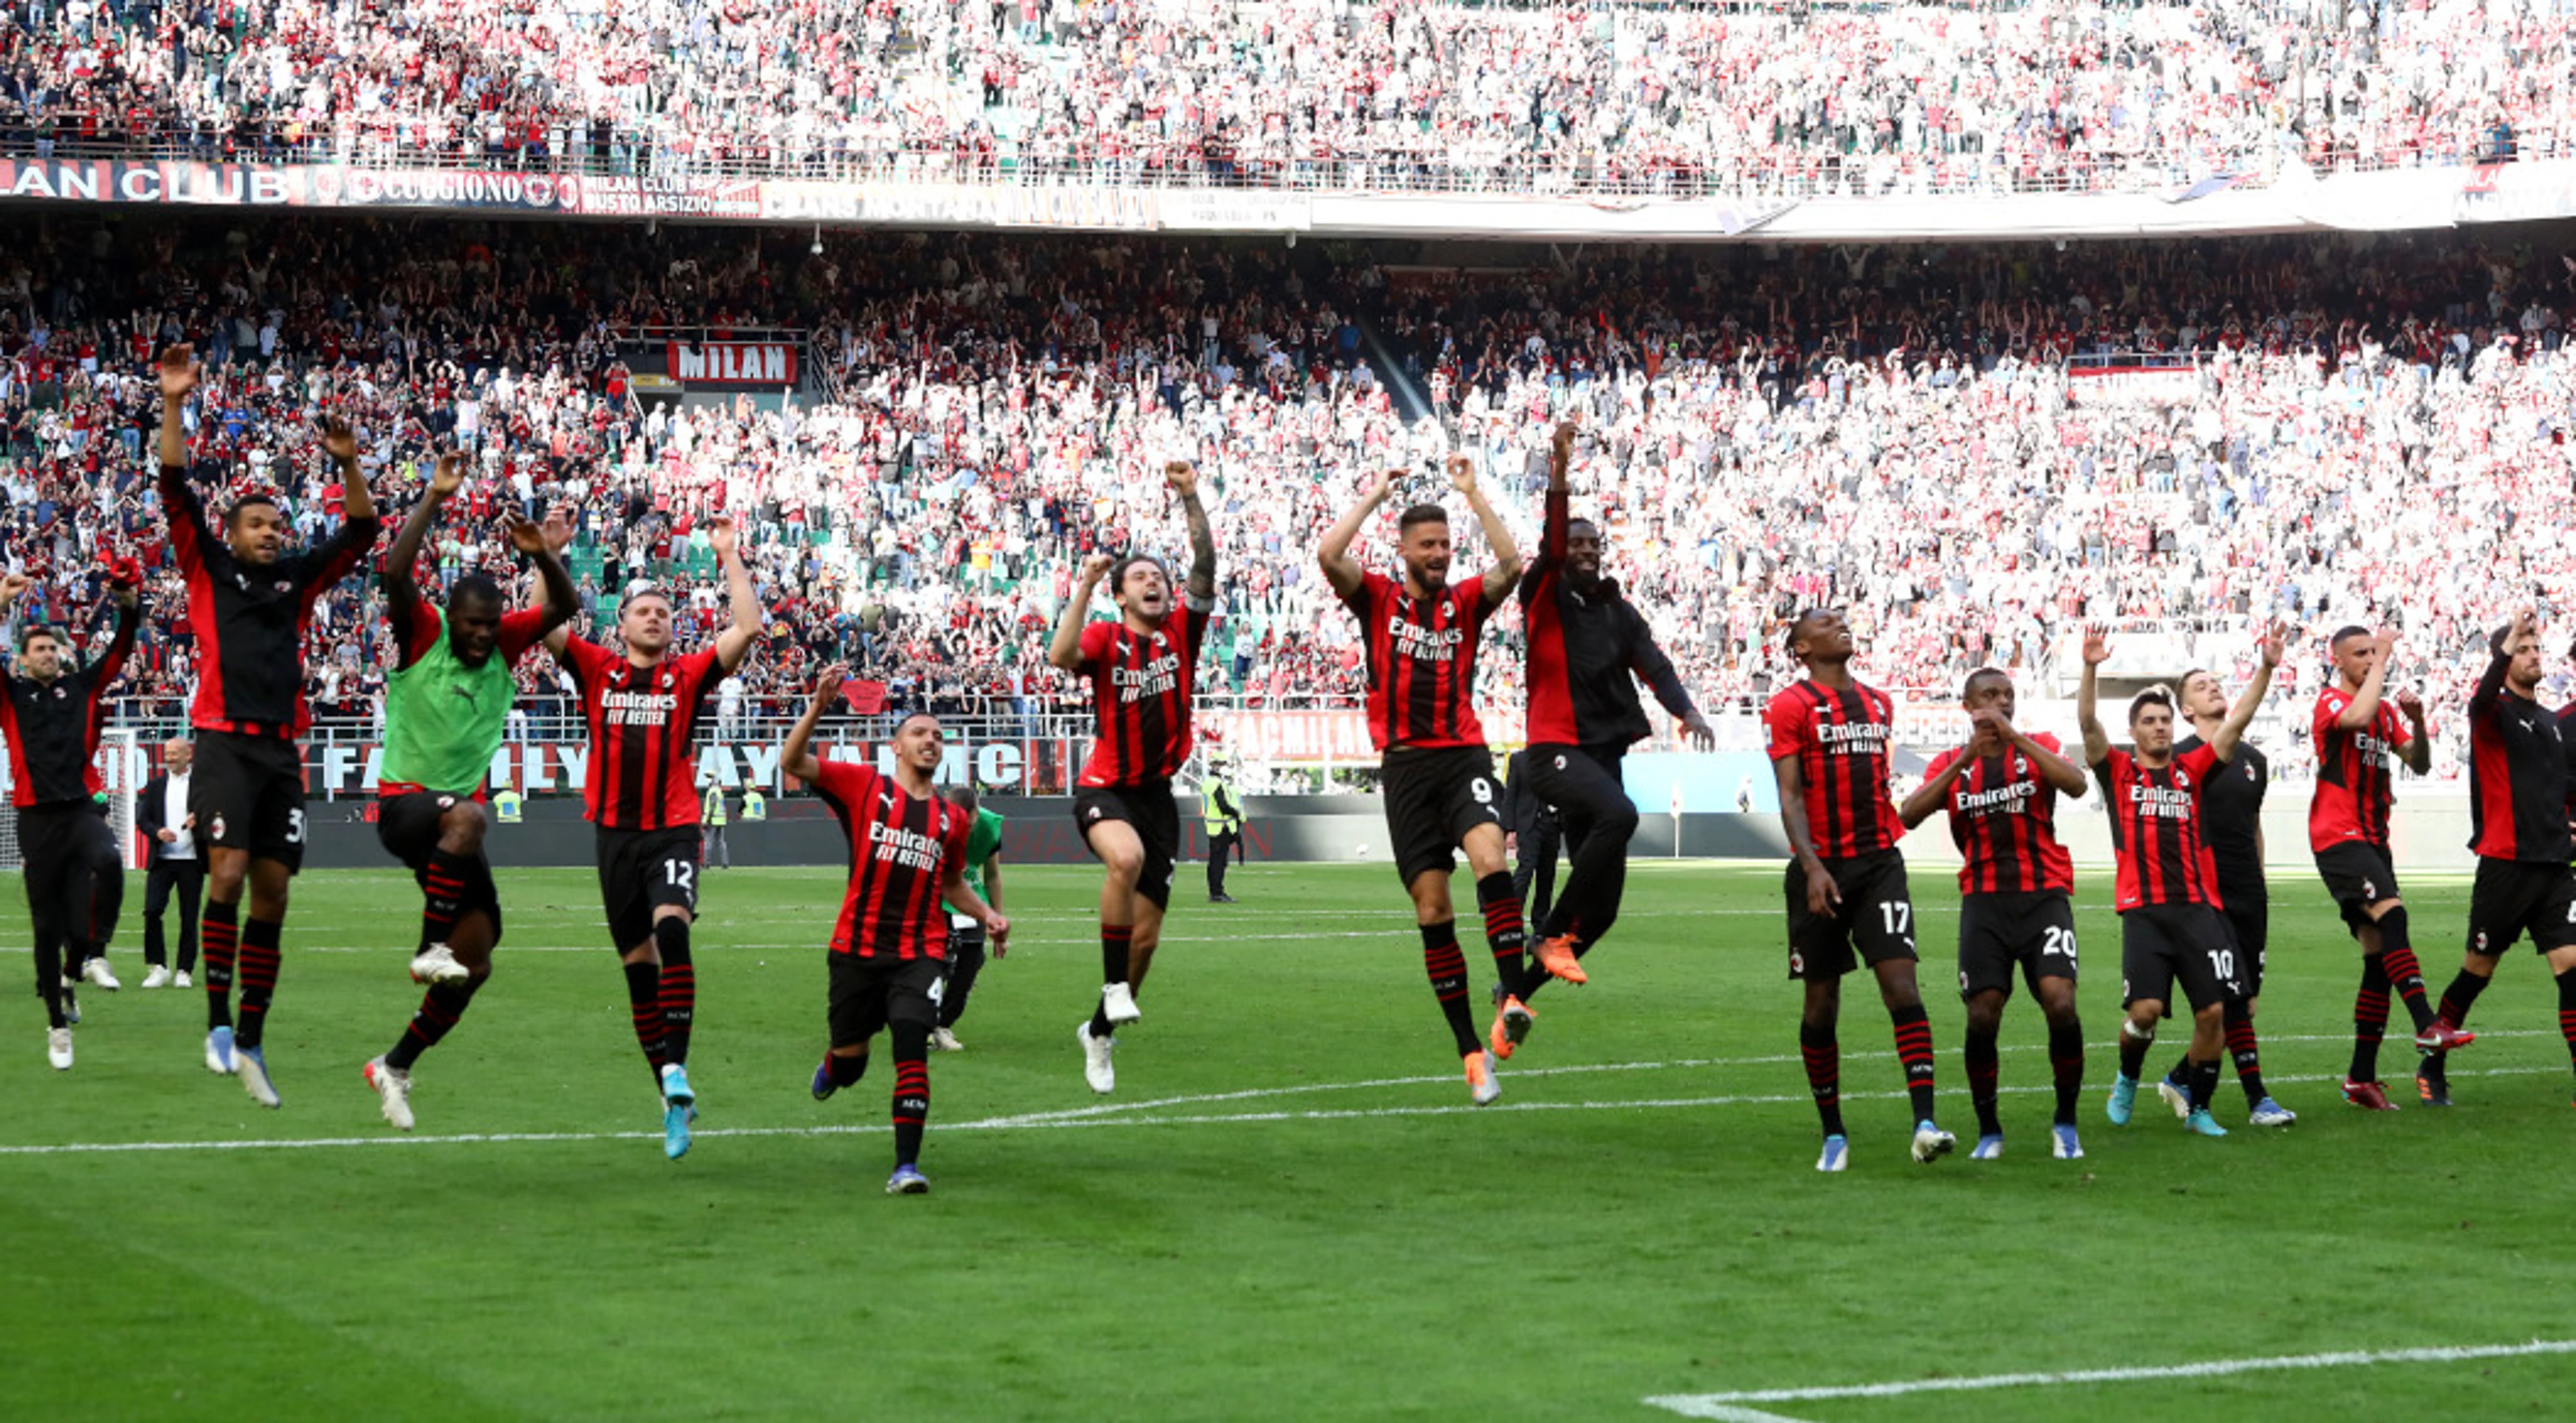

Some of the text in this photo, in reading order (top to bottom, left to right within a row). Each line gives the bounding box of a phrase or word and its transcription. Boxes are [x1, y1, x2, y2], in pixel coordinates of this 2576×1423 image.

[0, 166, 288, 203] AN CLUB
[382, 172, 521, 202] CUGGIONO
[583, 176, 637, 193] MILAN
[642, 178, 686, 193] CLUB
[584, 193, 711, 213] BUSTO ARSIZIO
[678, 346, 786, 380] MILAN
[1389, 615, 1463, 646] Emirates
[601, 687, 678, 710] Emirates
[1471, 778, 1493, 804] 9
[1955, 780, 2037, 811] Emirates
[286, 807, 307, 843] 3
[663, 858, 693, 890] 12
[1879, 900, 1910, 935] 17
[2043, 925, 2077, 958] 20
[2207, 949, 2234, 980] 10
[927, 976, 943, 1008] 4
